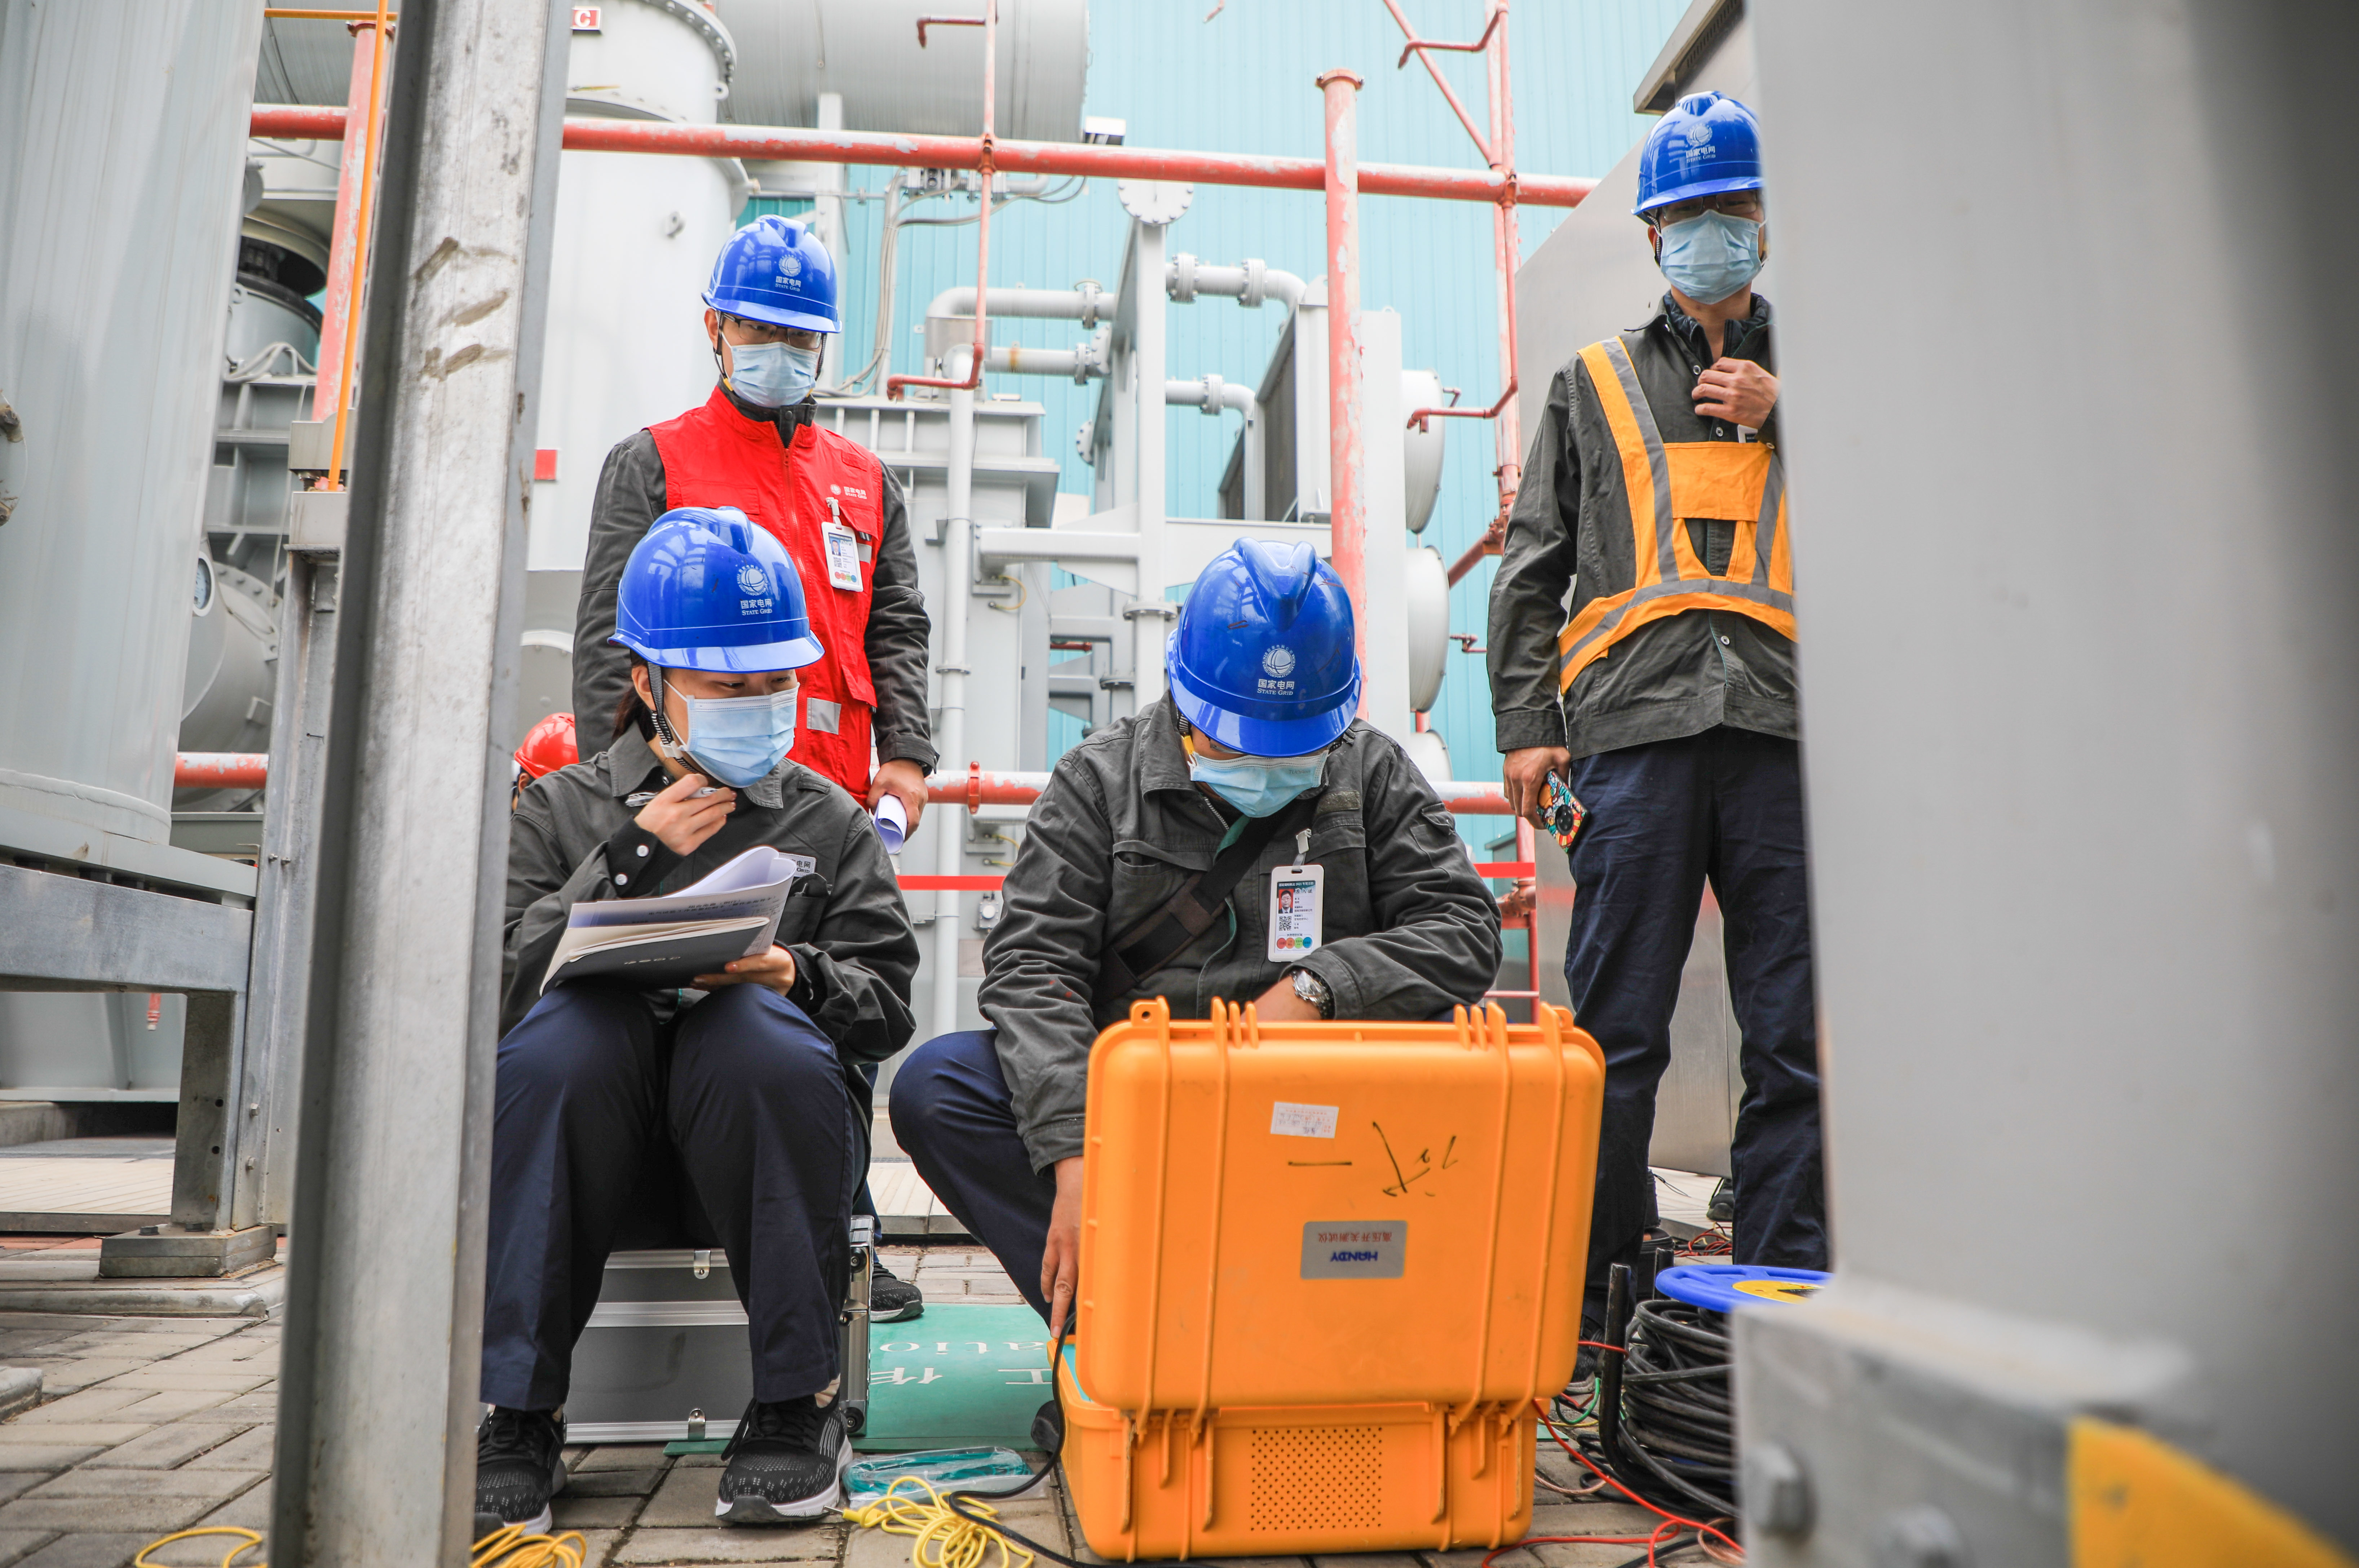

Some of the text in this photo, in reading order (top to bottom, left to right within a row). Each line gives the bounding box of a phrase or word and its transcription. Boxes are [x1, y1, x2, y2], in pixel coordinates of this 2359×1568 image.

[575, 10, 591, 28] C
[776, 276, 801, 288] 国家电网
[844, 486, 866, 496] 国家电网
[741, 599, 772, 609] 国家电网
[1258, 679, 1294, 690] 国家电网
[792, 859, 810, 869] 电网
[1318, 1232, 1392, 1243] 高压开关测试仪
[1330, 1251, 1378, 1262] HANDY
